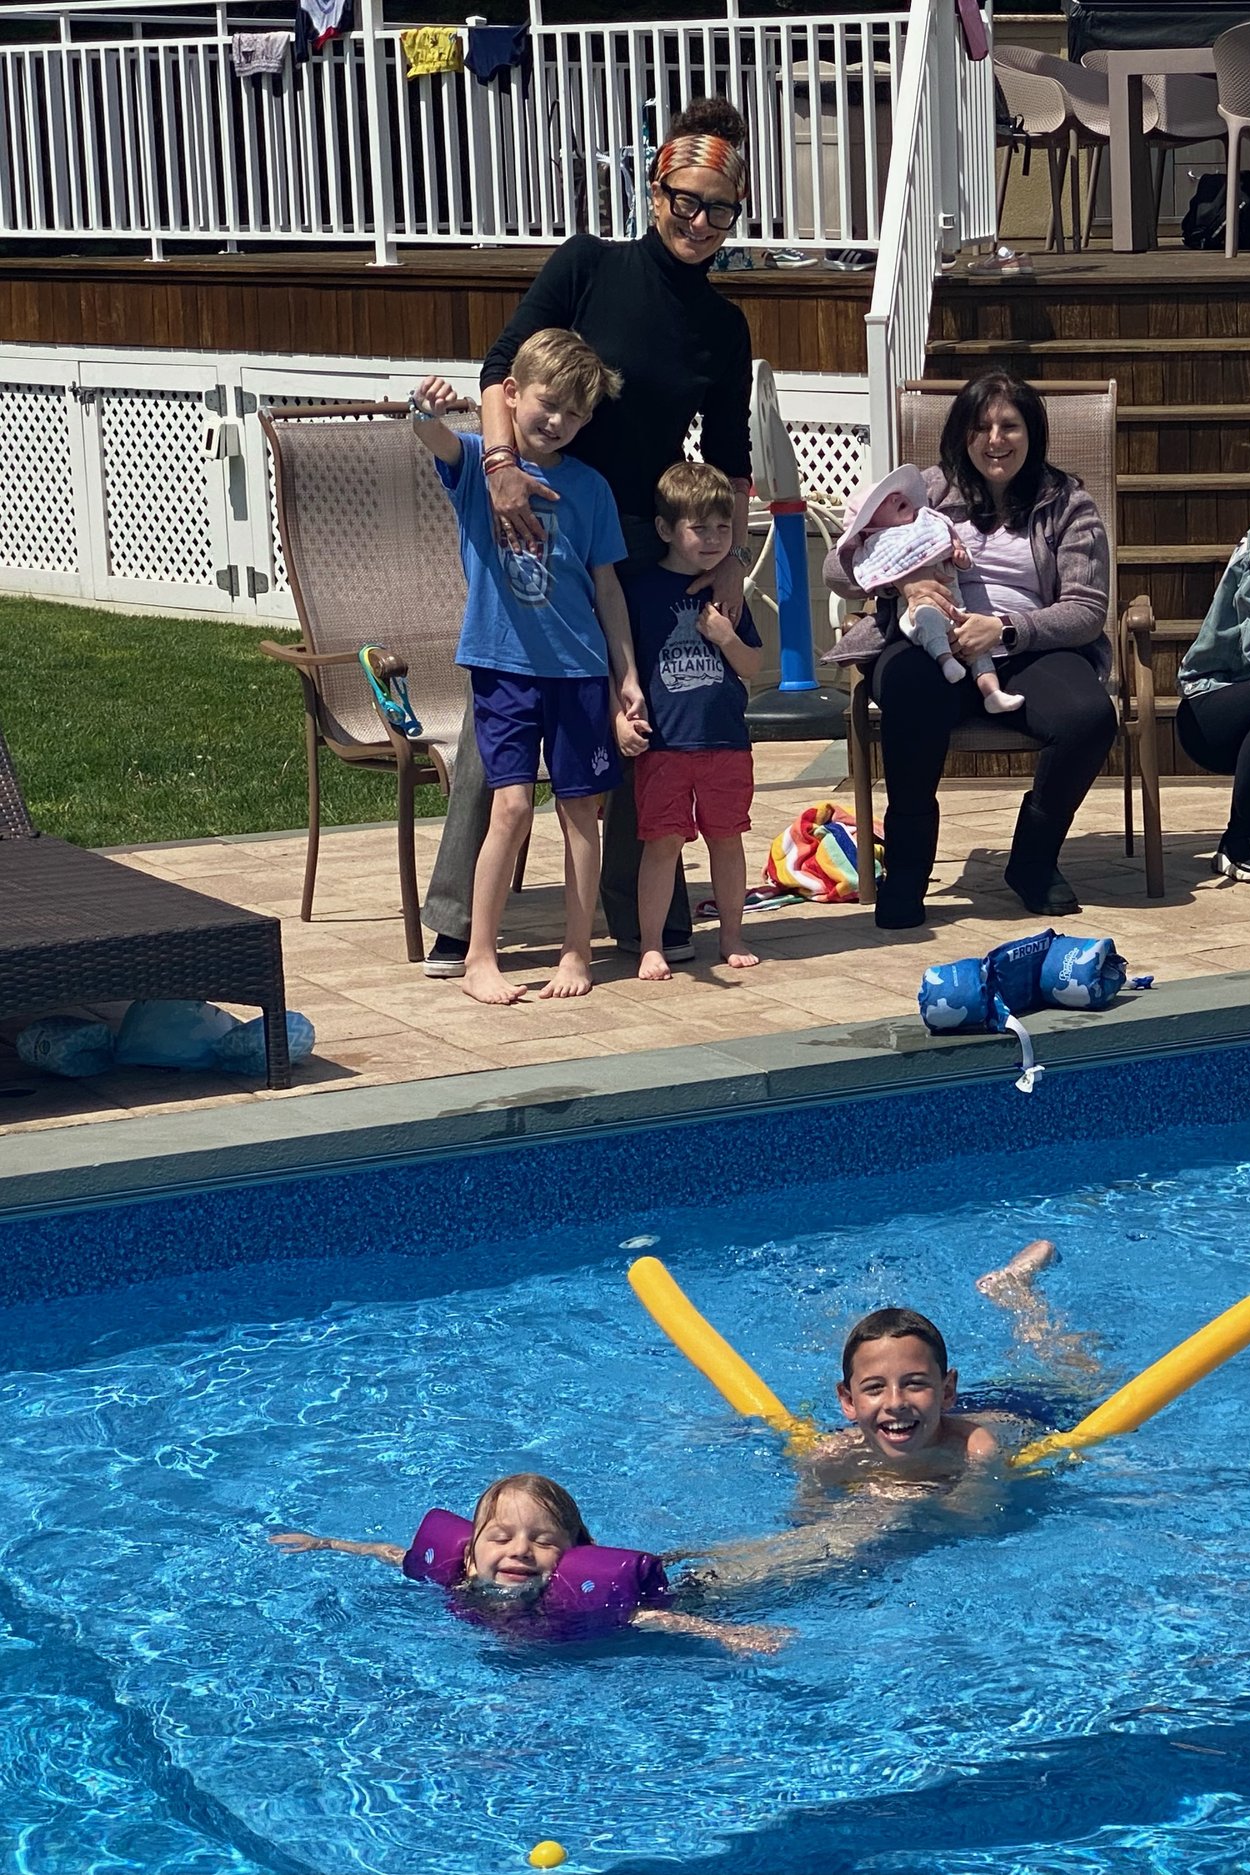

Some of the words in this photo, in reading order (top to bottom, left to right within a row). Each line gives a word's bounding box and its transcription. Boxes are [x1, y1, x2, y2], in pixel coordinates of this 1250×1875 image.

[661, 645, 711, 662] ROYAL
[661, 658, 723, 675] ATLANTIC
[1011, 939, 1047, 961] FRONT
